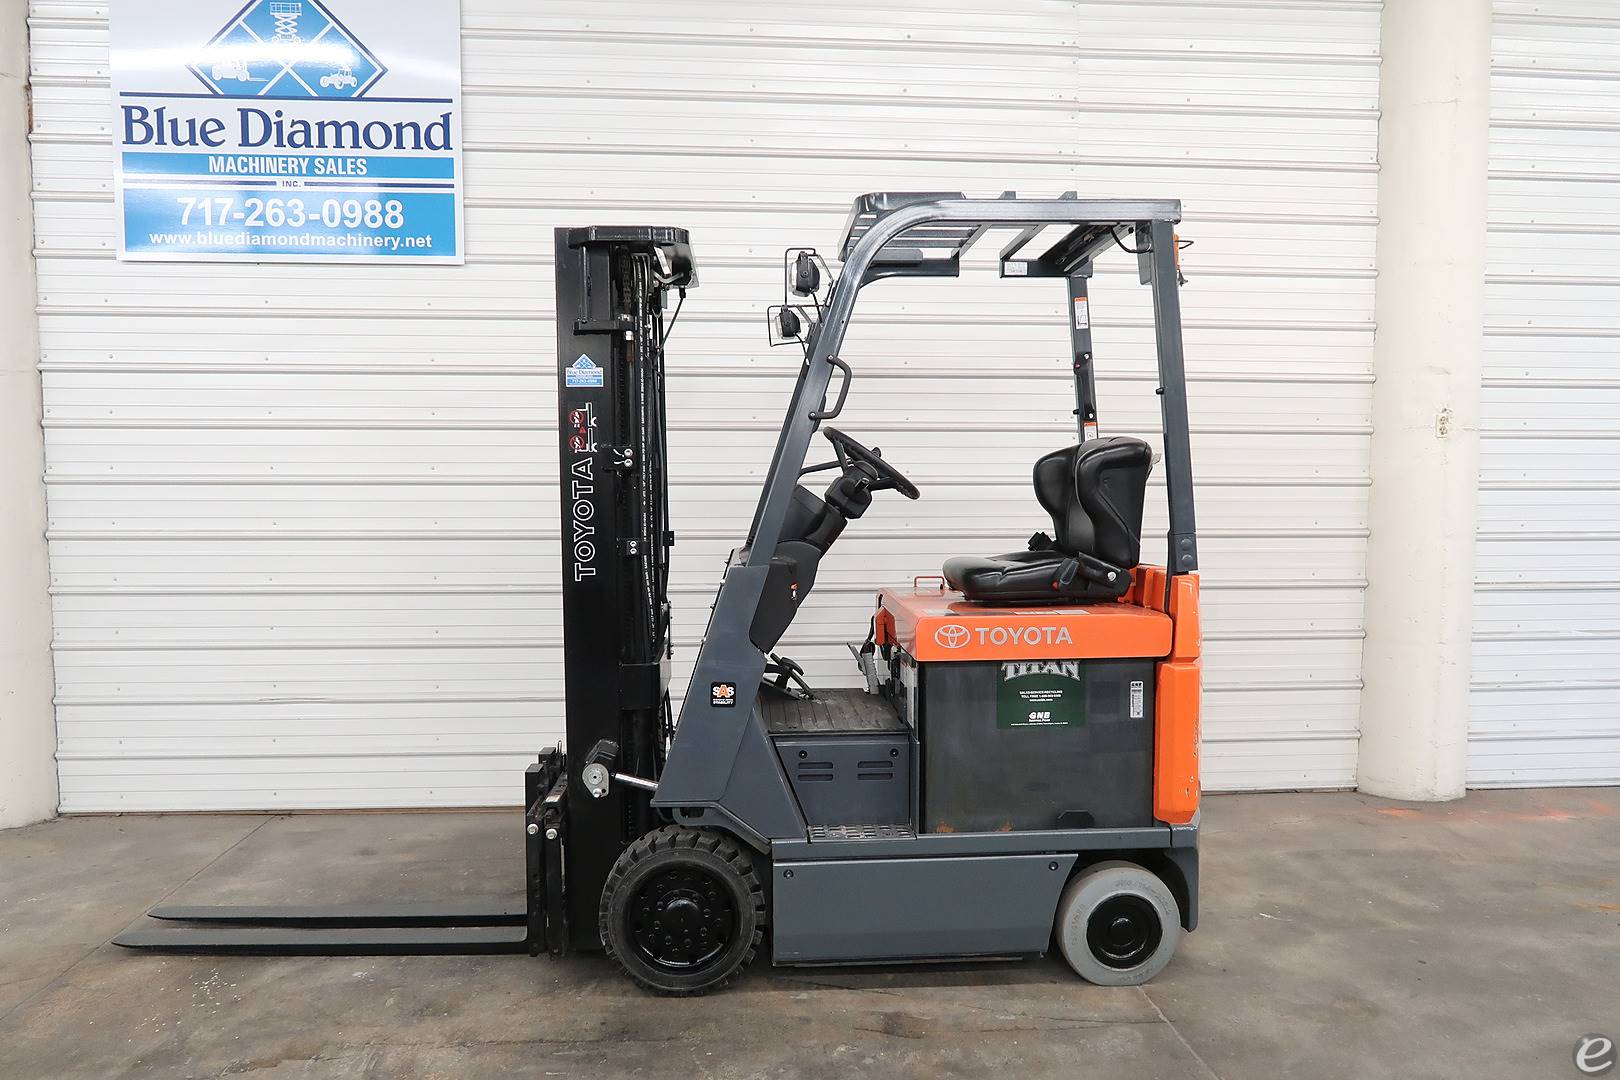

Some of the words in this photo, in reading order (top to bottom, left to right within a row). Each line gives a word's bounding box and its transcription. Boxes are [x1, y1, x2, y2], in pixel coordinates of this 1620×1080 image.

[121, 105, 226, 147] Blue
[237, 108, 453, 150] Diamond
[208, 156, 309, 175] MACHINERY
[314, 157, 368, 175] SALES
[282, 180, 302, 188] INC.
[176, 196, 405, 229] 717-263-0988
[148, 231, 433, 251] www.bluediamondmachinery.net
[572, 457, 596, 582] TOYOTA
[974, 626, 1073, 646] TOYOTA
[1001, 661, 1081, 682] TITAN
[712, 684, 735, 698] SAS
